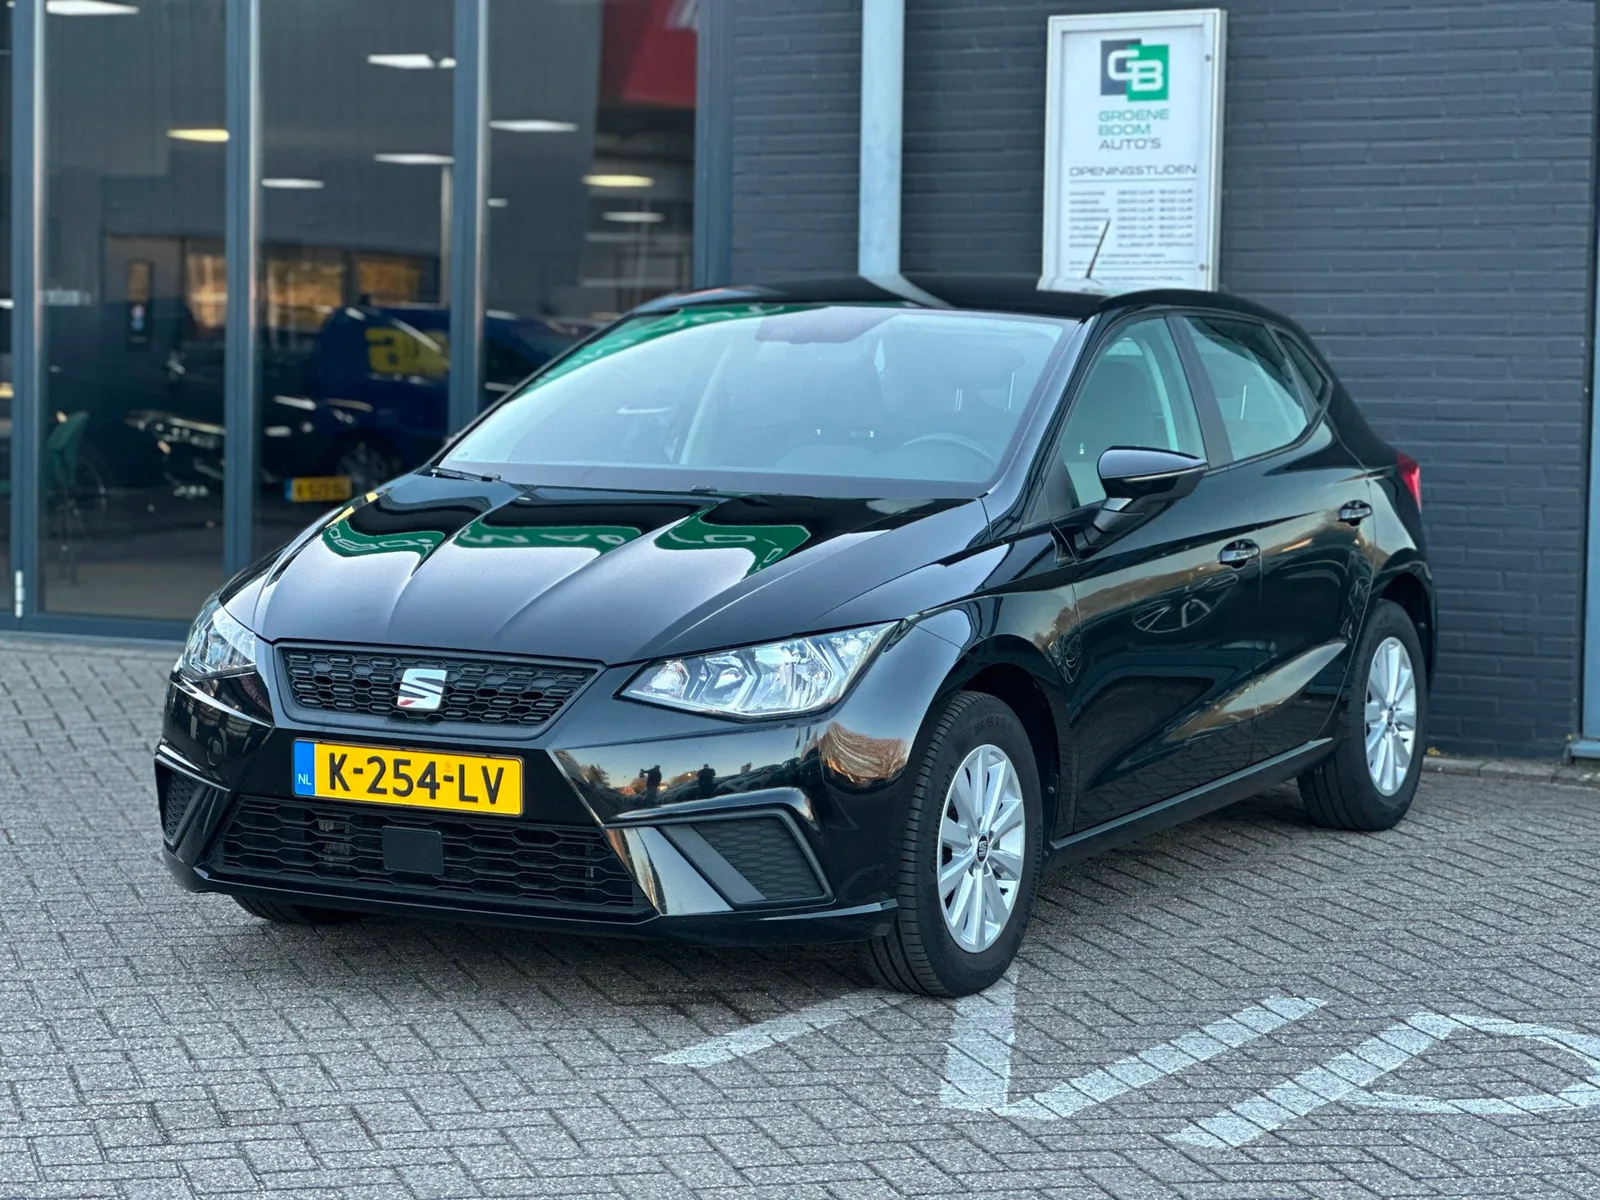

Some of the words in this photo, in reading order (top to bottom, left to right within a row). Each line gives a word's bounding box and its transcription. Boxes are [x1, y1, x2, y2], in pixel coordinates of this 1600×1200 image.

[1098, 108, 1170, 122] GROENE
[1098, 123, 1152, 137] BOOM
[1099, 137, 1162, 150] AUTO'S
[297, 772, 312, 786] NL
[328, 752, 505, 805] K-254-LV
